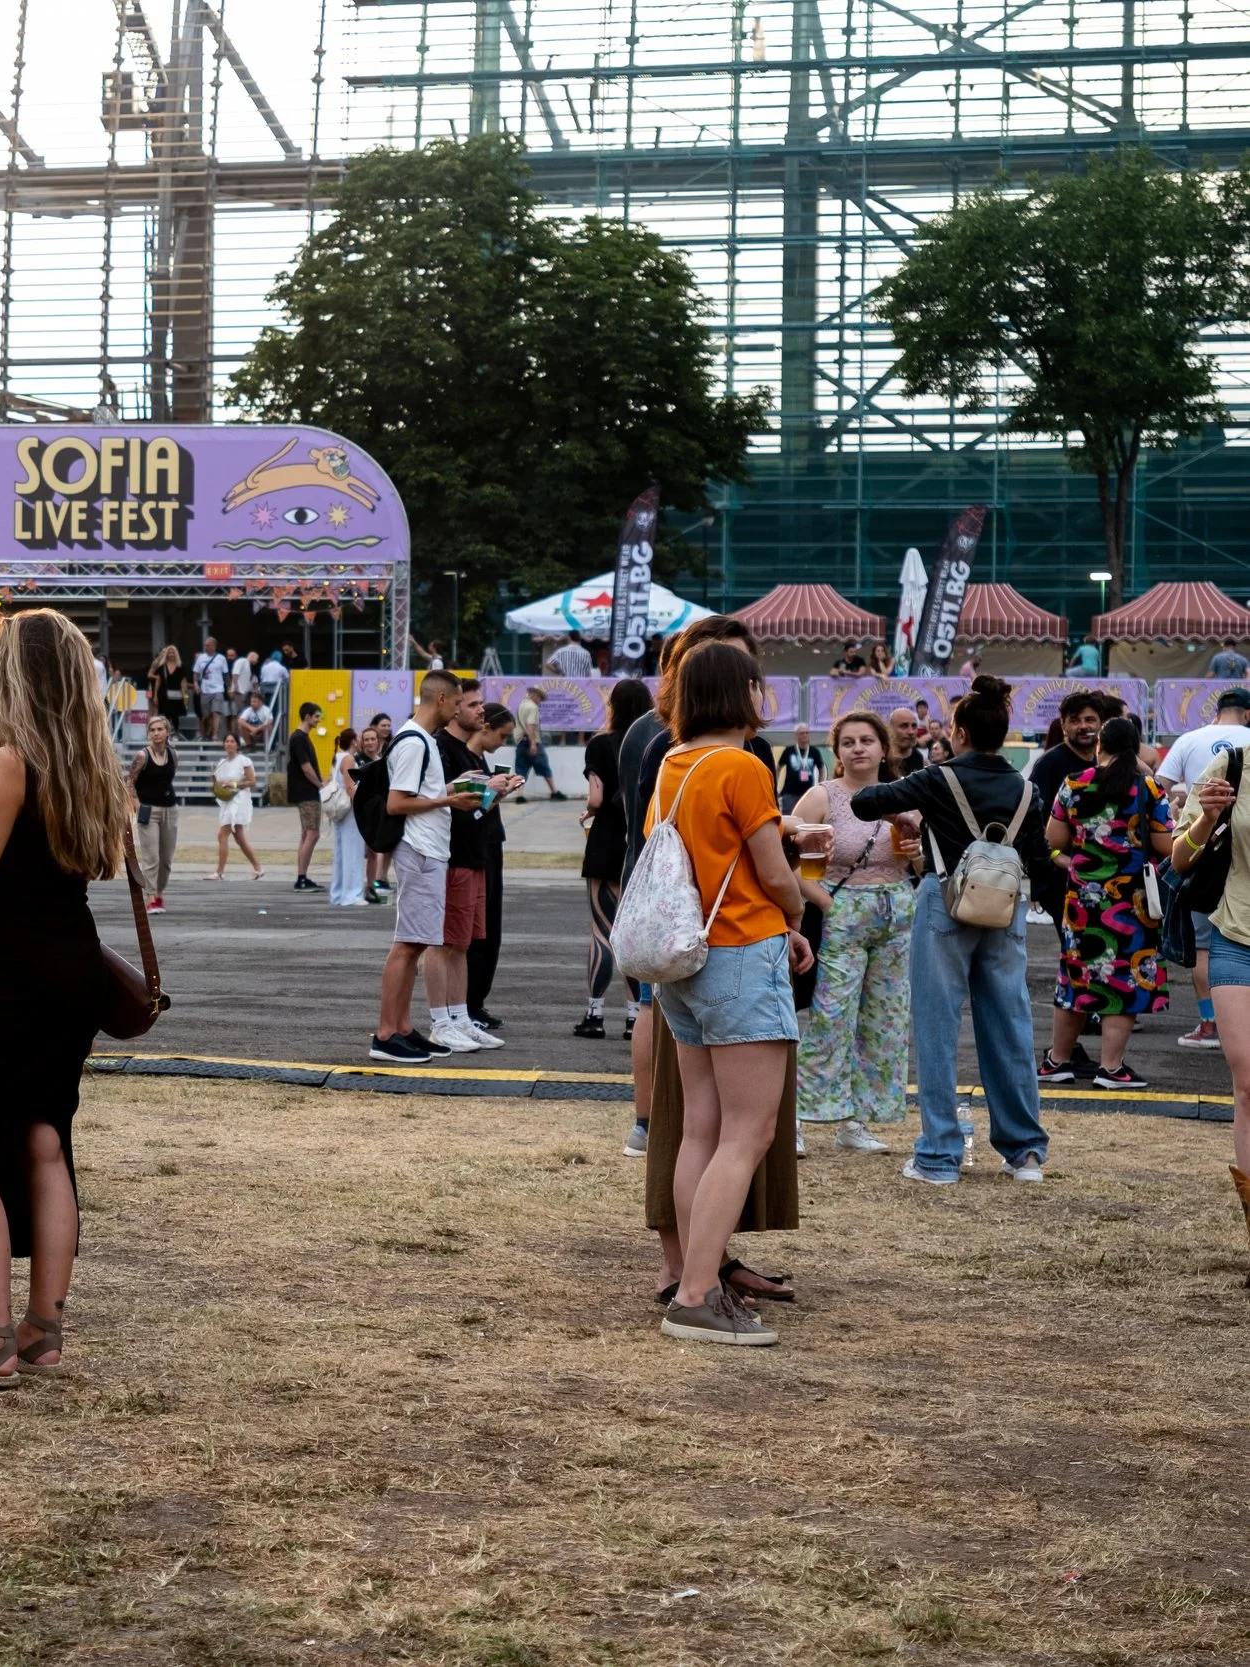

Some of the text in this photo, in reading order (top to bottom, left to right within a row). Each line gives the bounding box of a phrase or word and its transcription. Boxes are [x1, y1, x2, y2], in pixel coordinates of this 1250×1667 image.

[14, 436, 180, 495] SOFIA
[14, 500, 180, 541] LIVE FEST
